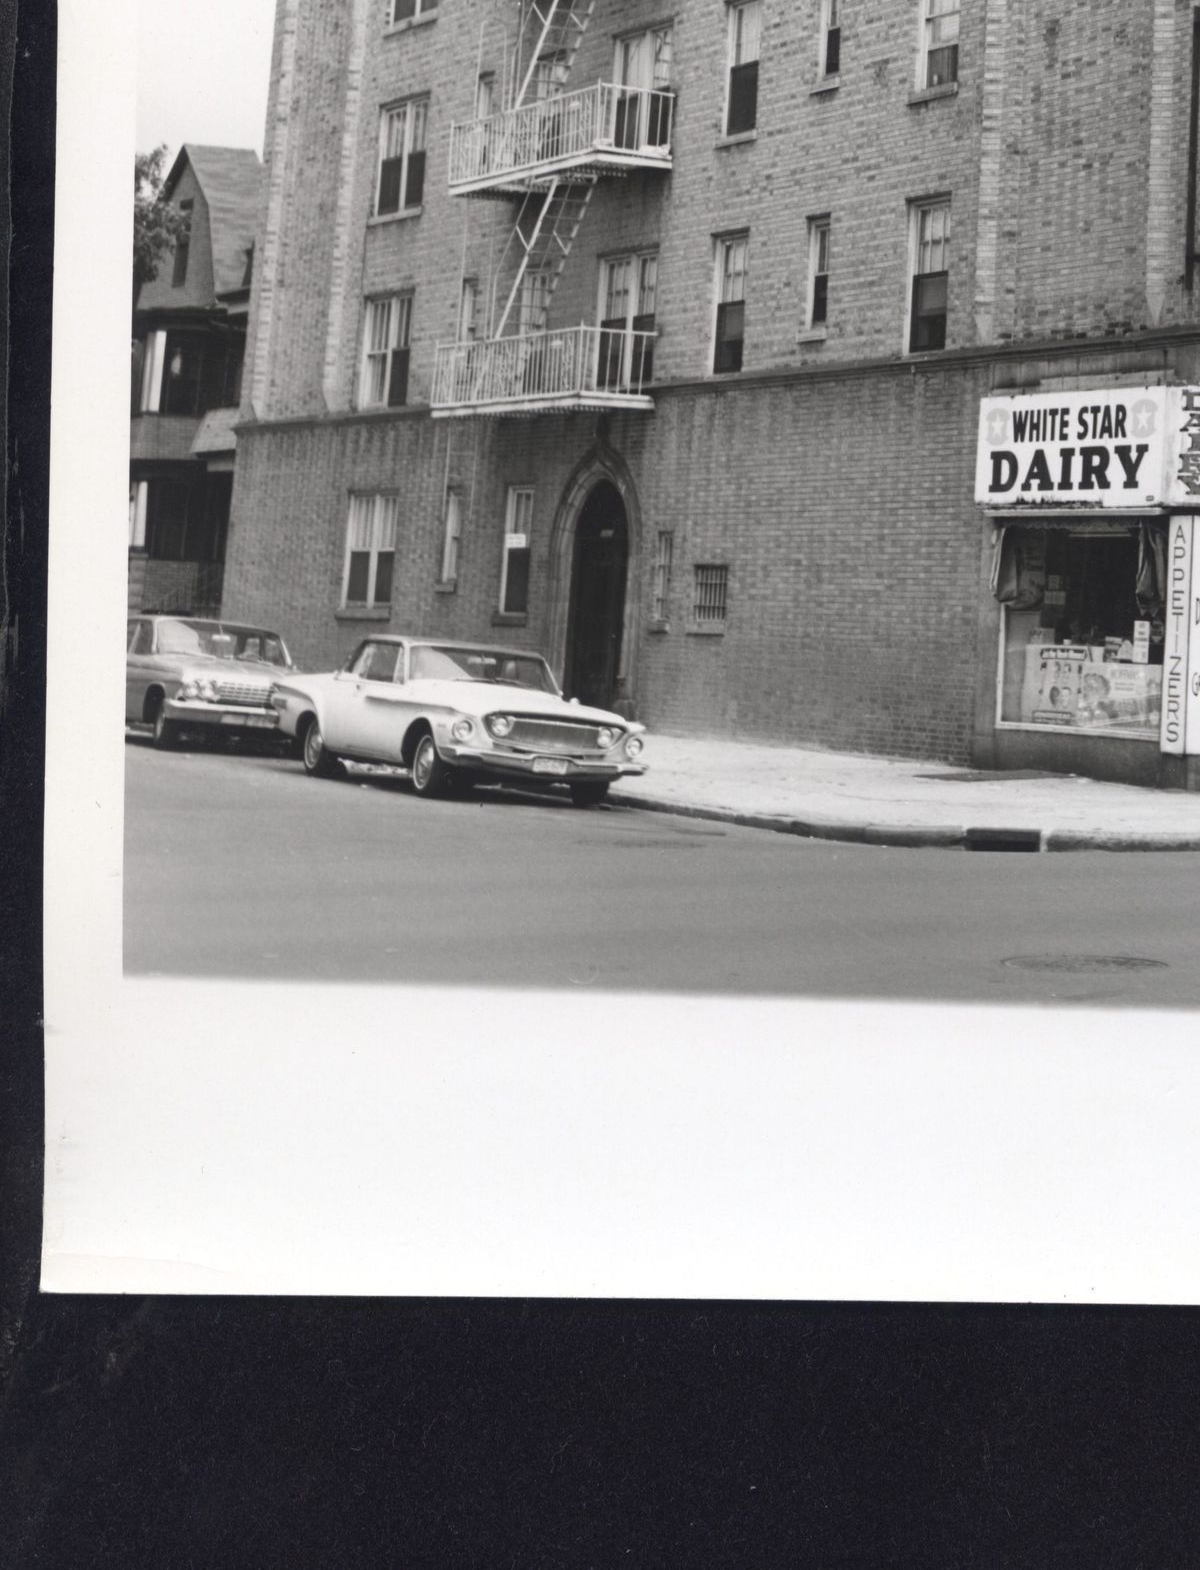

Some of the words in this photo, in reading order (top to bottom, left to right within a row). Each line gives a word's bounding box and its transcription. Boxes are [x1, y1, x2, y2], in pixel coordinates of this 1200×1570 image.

[1013, 408, 1070, 443] WHITE
[1077, 404, 1127, 440] STAR
[988, 444, 1149, 492] DAIRY
[1166, 524, 1187, 743] APPETIZERS
